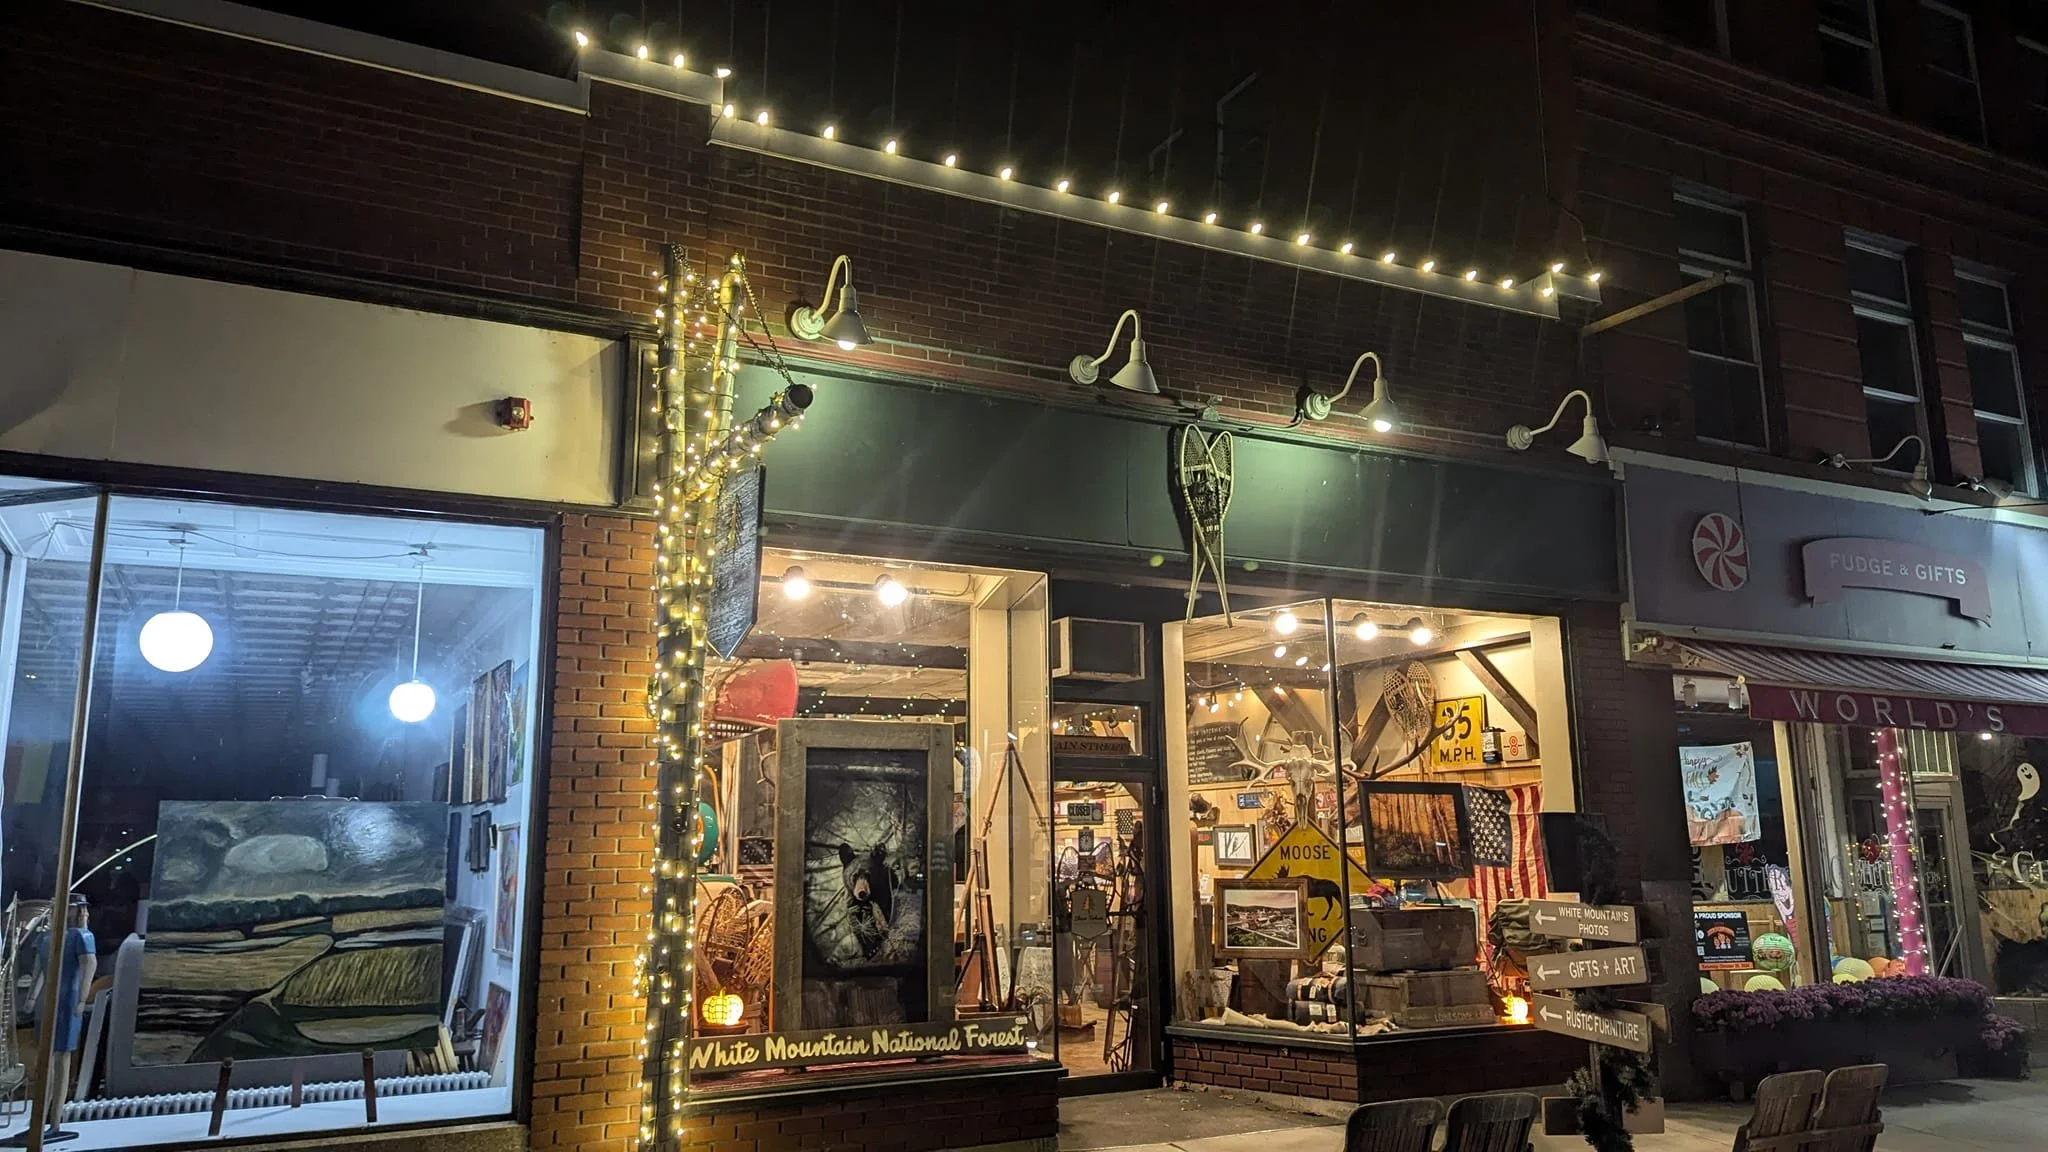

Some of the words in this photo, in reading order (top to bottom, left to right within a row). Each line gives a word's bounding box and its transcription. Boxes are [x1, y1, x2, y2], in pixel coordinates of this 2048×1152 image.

[1829, 553, 1893, 576] FUDGE
[1900, 565, 1909, 576] &
[1915, 563, 1967, 585] GIFTS
[1789, 689, 2005, 732] WORLD'S
[1442, 704, 1472, 741] 35
[1055, 740, 1078, 752] AIN
[1068, 805, 1090, 817] CLOSED
[1280, 844, 1331, 861] MOOSE
[1558, 906, 1582, 919] WHITE
[1584, 908, 1629, 922] MOUNTAINS
[1717, 911, 1742, 919] SPONSOR
[1308, 928, 1327, 943] NG
[1578, 923, 1609, 936] PHOTOS
[1568, 960, 1600, 979] GIFTS
[1613, 956, 1636, 975] ART
[1565, 1009, 1593, 1032] RUSTIC
[1594, 1016, 1639, 1042] FURNITURE
[689, 1040, 759, 1070] White
[764, 1035, 869, 1062] Mountain
[872, 1028, 961, 1056] National
[963, 1023, 1025, 1048] Forest
